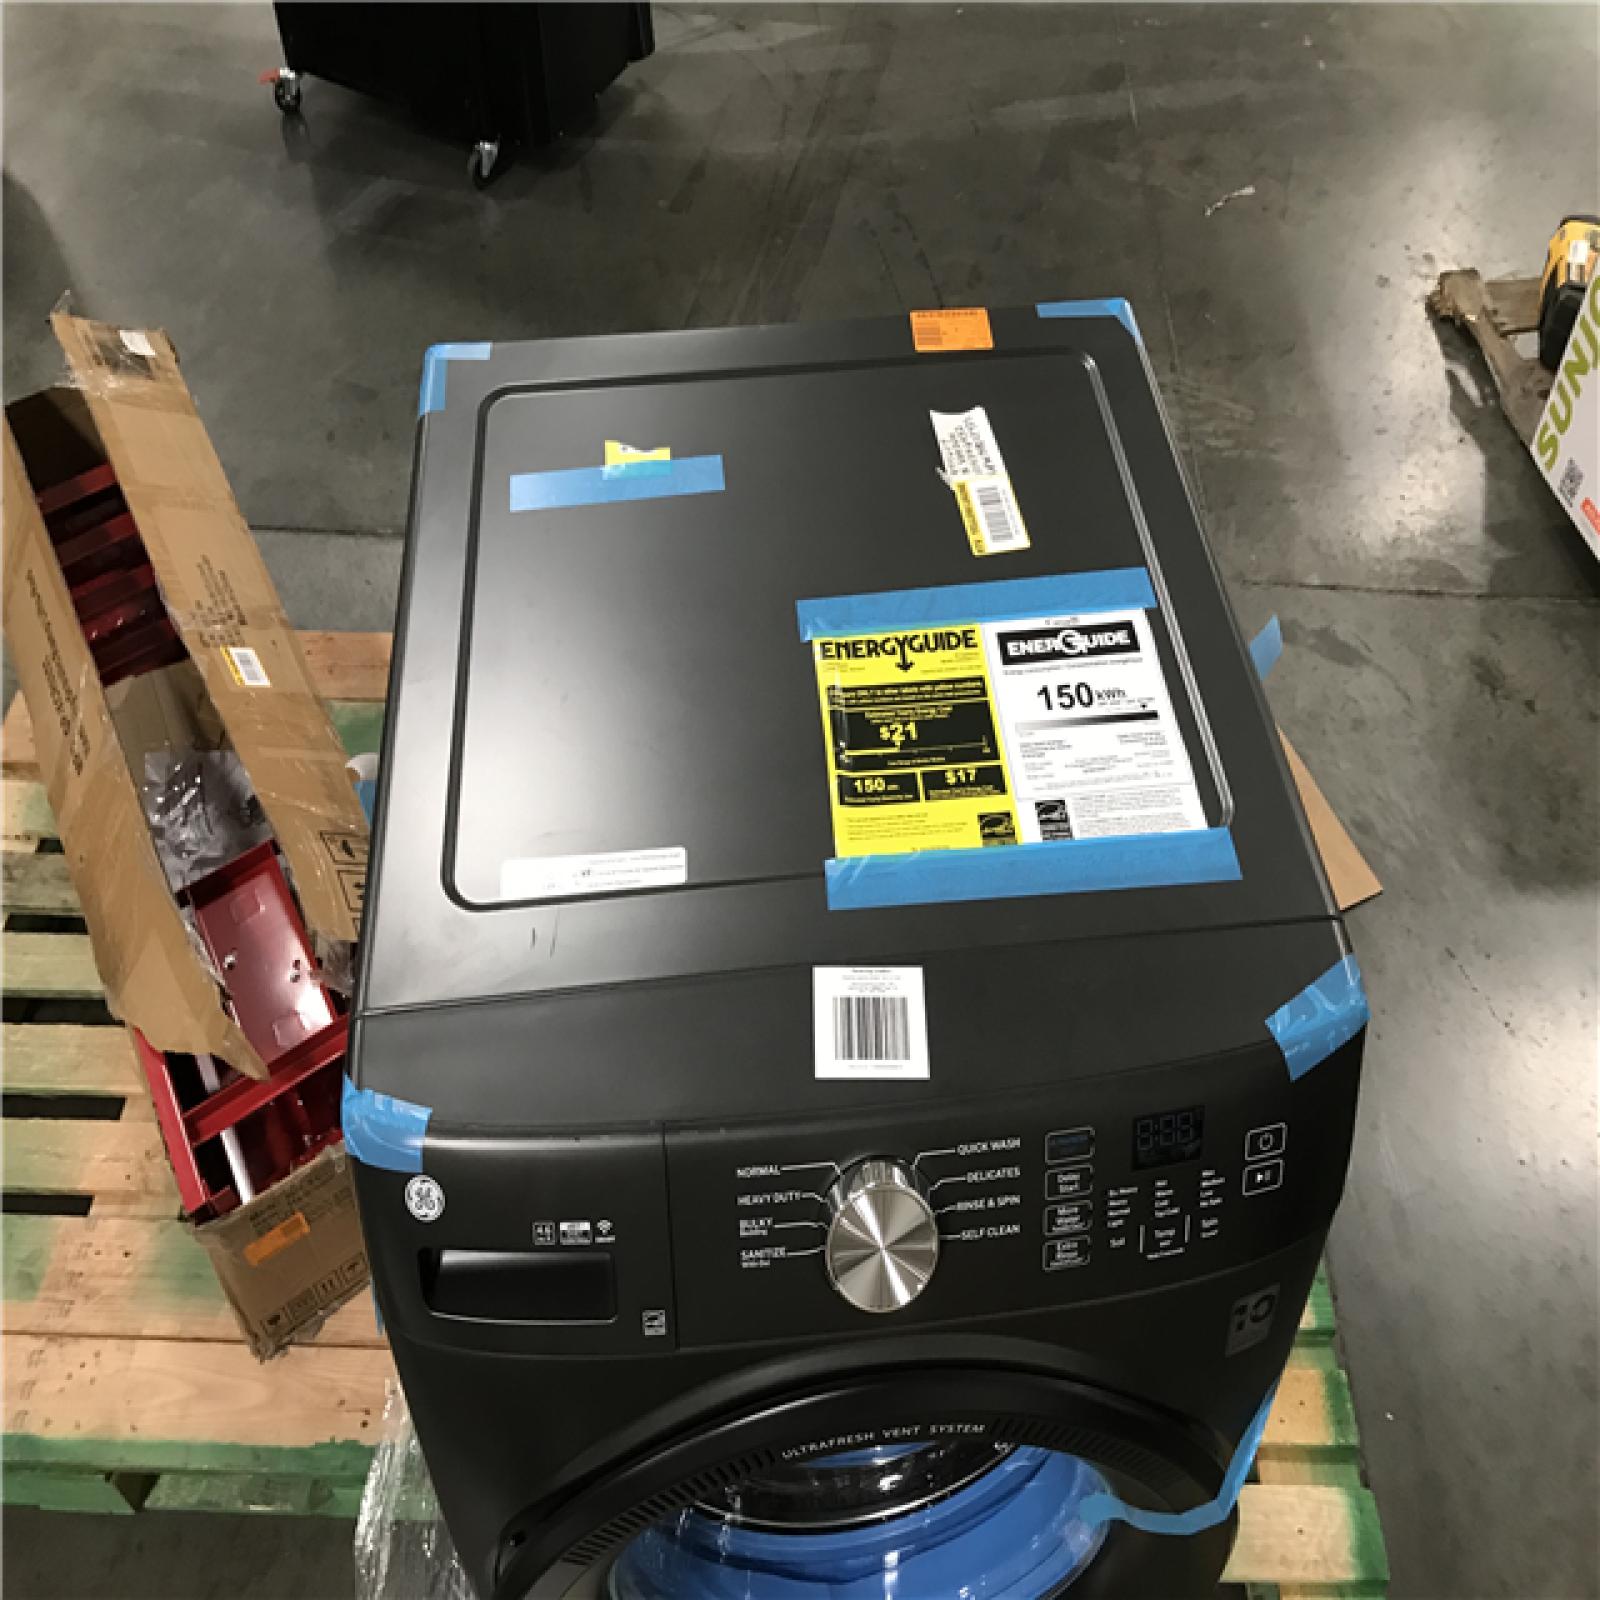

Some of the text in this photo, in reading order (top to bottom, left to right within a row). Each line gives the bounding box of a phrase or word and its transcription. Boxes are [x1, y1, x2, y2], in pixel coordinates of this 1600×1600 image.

[1037, 681, 1094, 711] 150
[879, 721, 919, 741] $21
[853, 777, 886, 793] 150
[990, 1136, 1021, 1150] WASH
[736, 1165, 781, 1178] NORMAL
[966, 1166, 1021, 1183] DELICATES
[986, 1223, 1021, 1238] CLEAN
